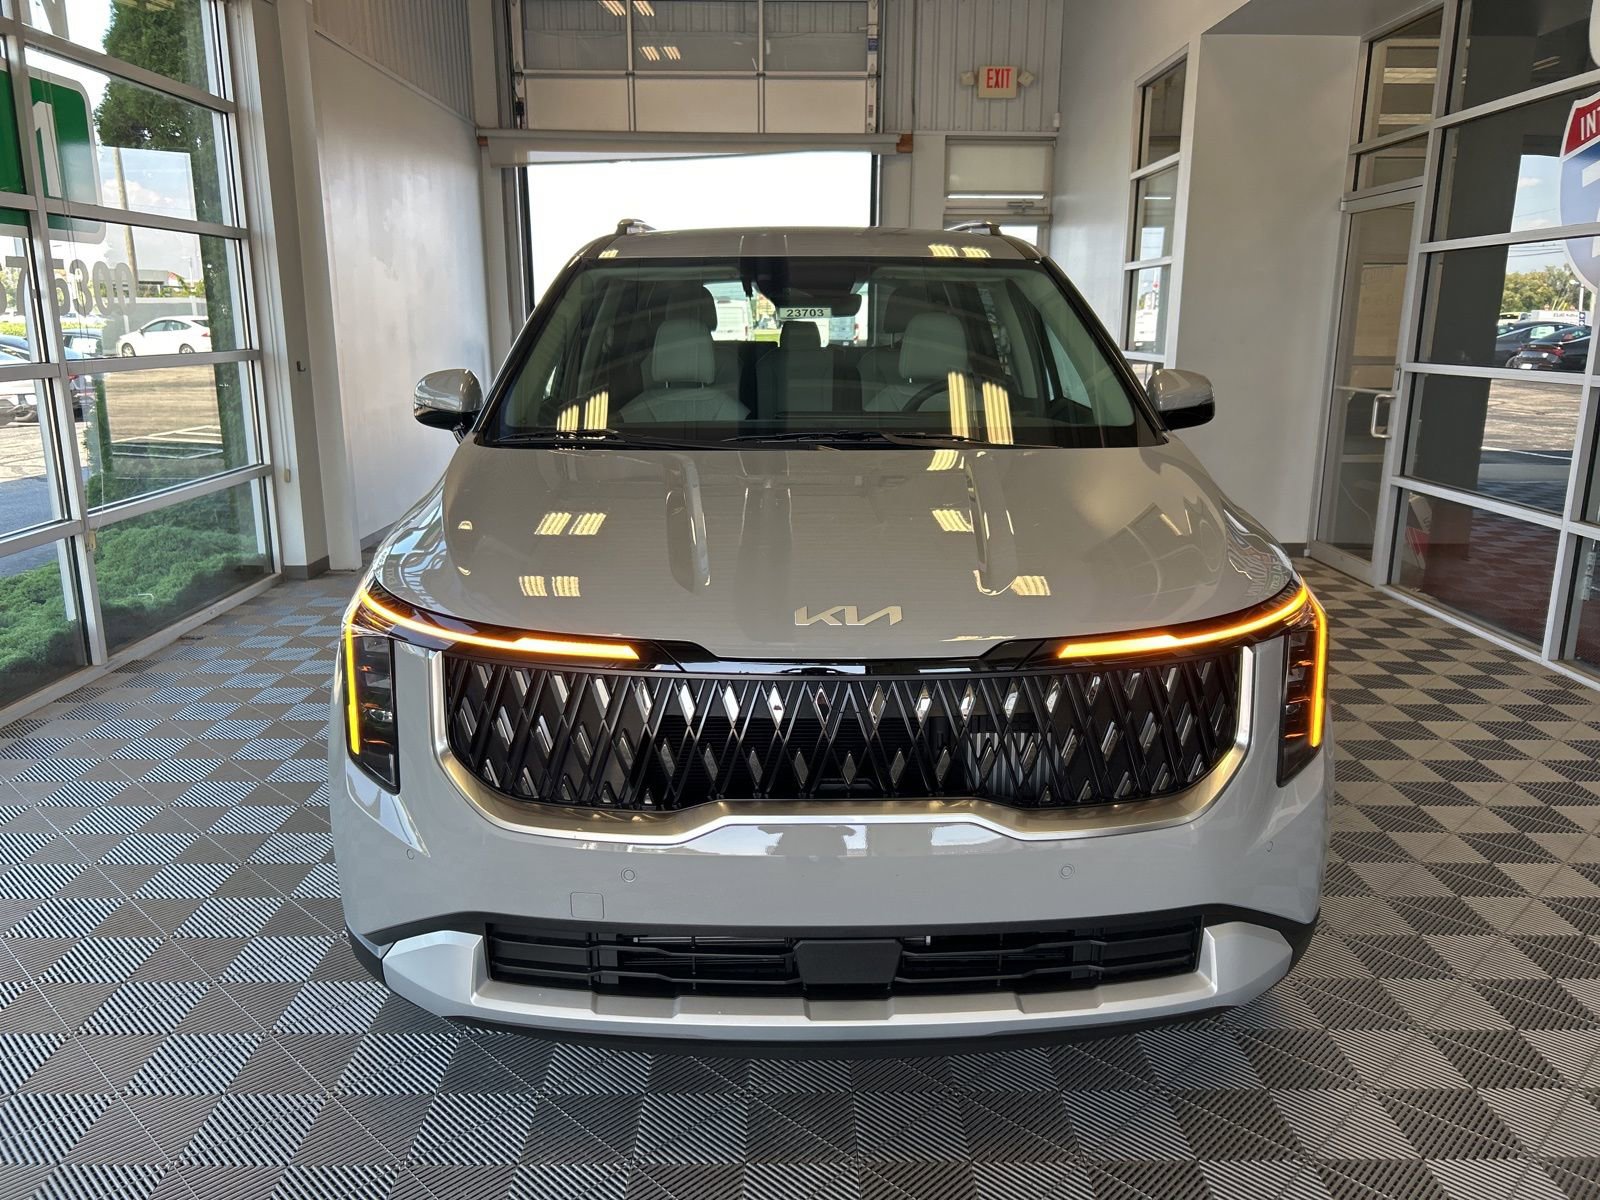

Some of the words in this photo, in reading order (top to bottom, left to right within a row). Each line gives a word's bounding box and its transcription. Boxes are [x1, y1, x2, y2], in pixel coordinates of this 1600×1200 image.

[986, 68, 1012, 89] EXIT
[1580, 108, 1600, 141] IN
[786, 308, 825, 318] 23703
[794, 605, 903, 627] KIA
